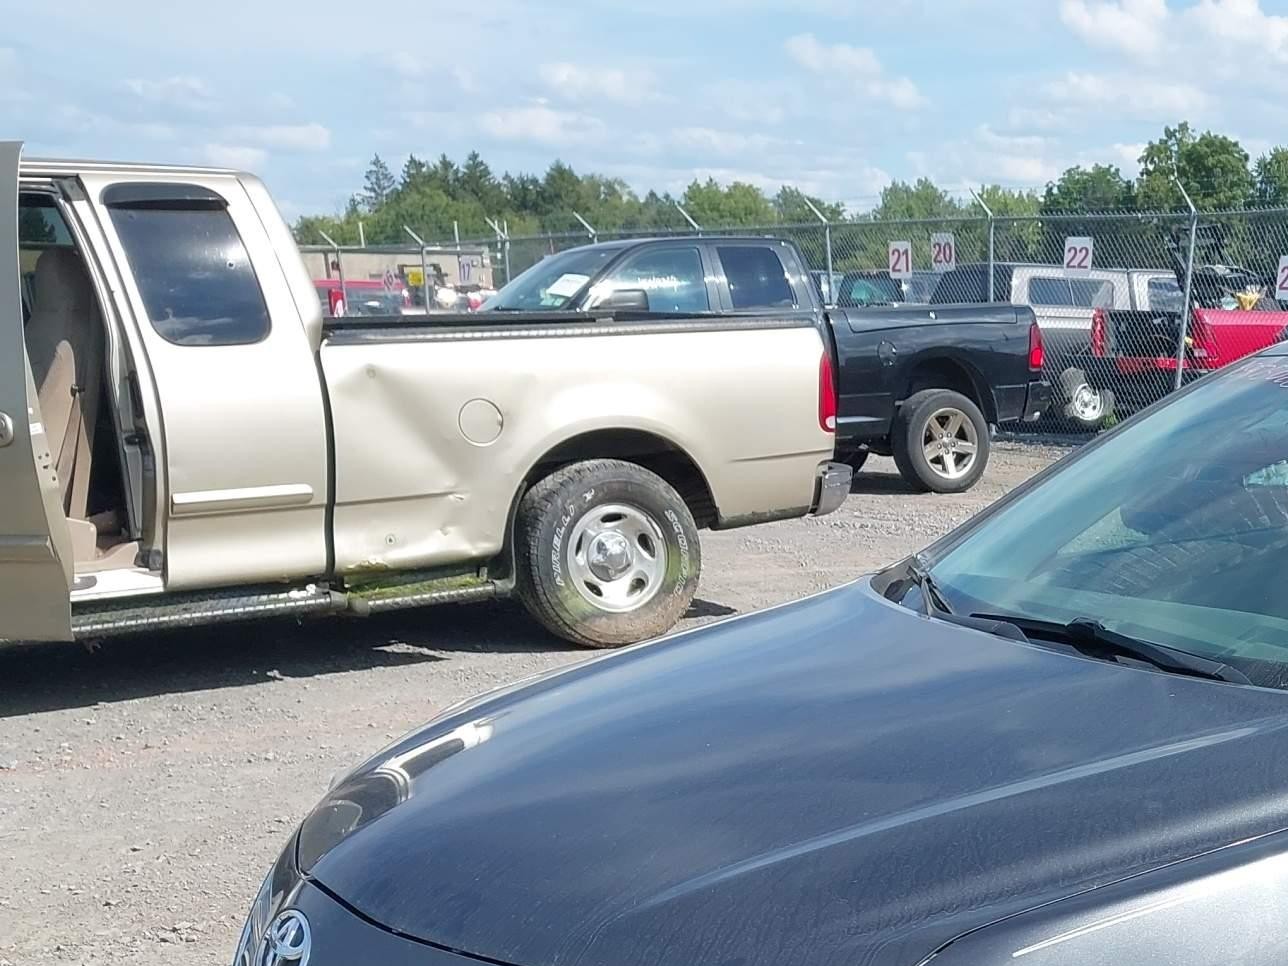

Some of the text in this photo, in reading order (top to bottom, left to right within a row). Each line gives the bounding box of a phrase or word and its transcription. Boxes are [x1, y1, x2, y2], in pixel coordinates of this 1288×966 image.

[891, 248, 910, 273] 21
[932, 242, 953, 265] 20
[1066, 246, 1089, 269] 22
[664, 509, 690, 602] SCORPIO
